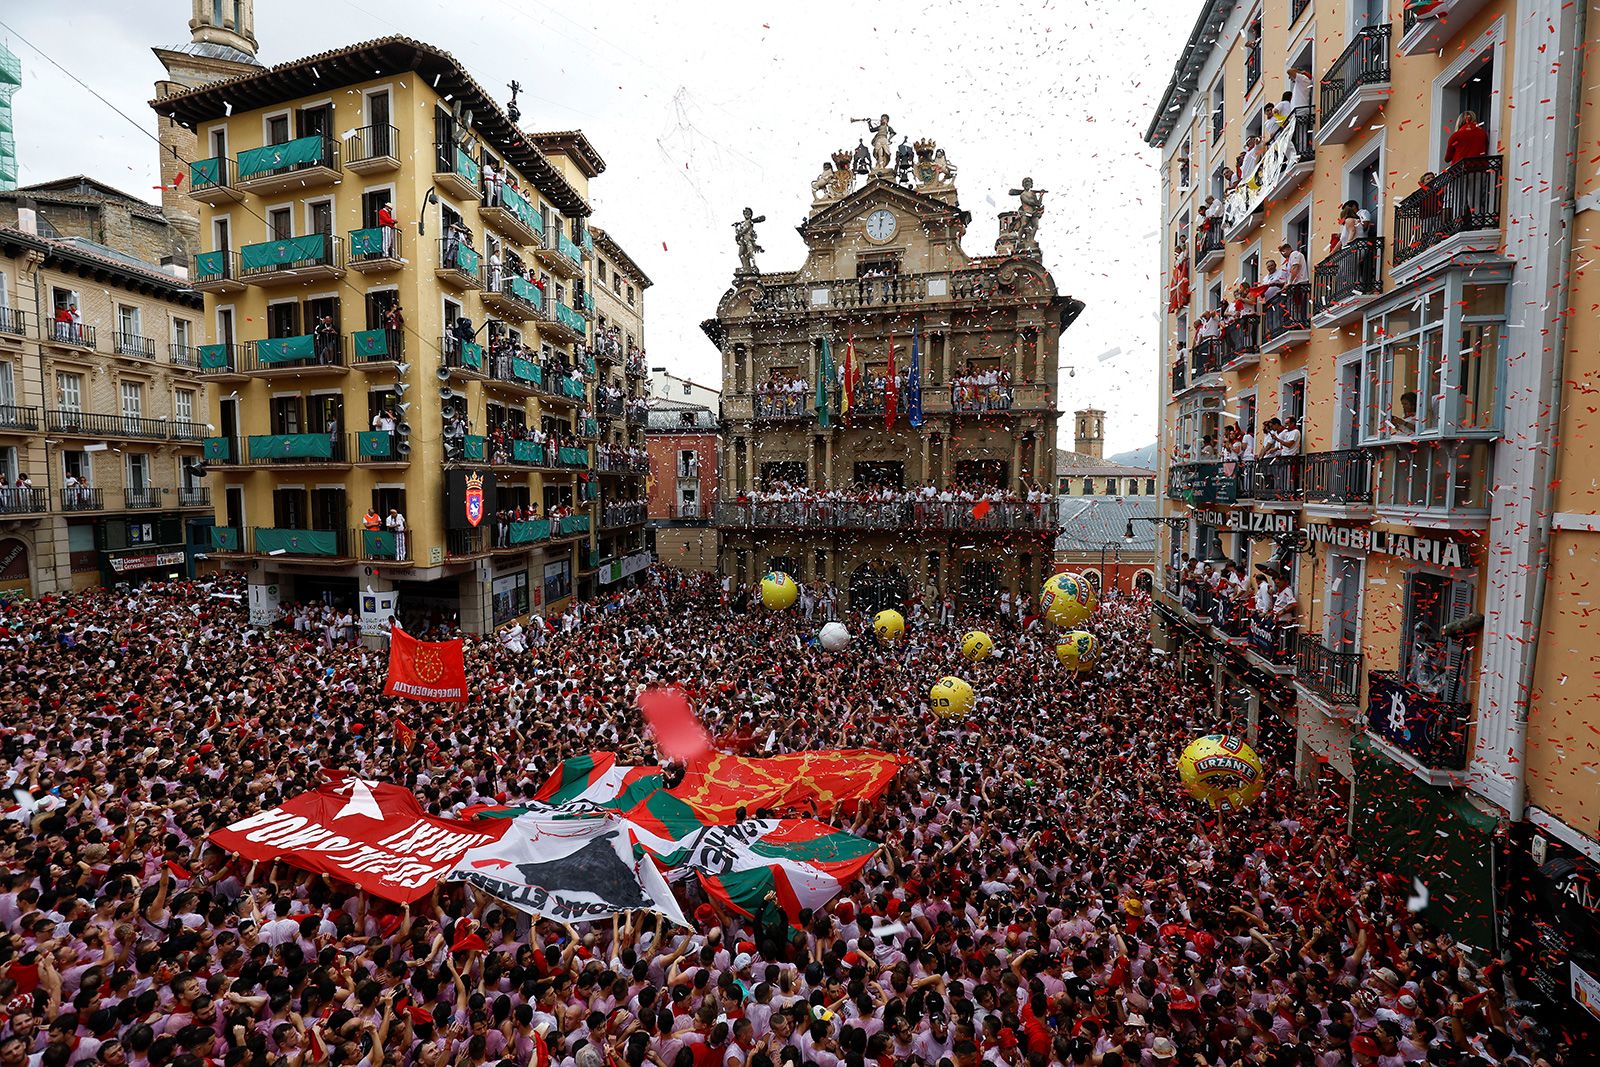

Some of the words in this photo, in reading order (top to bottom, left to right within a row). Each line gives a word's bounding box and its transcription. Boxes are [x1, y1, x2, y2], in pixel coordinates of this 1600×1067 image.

[1192, 509, 1223, 525] GENCIA
[1230, 510, 1293, 532] ELIZARI
[1306, 523, 1461, 568] INMOBILIARIA
[1200, 758, 1254, 778] URZANTE
[376, 818, 495, 863] RAIKI
